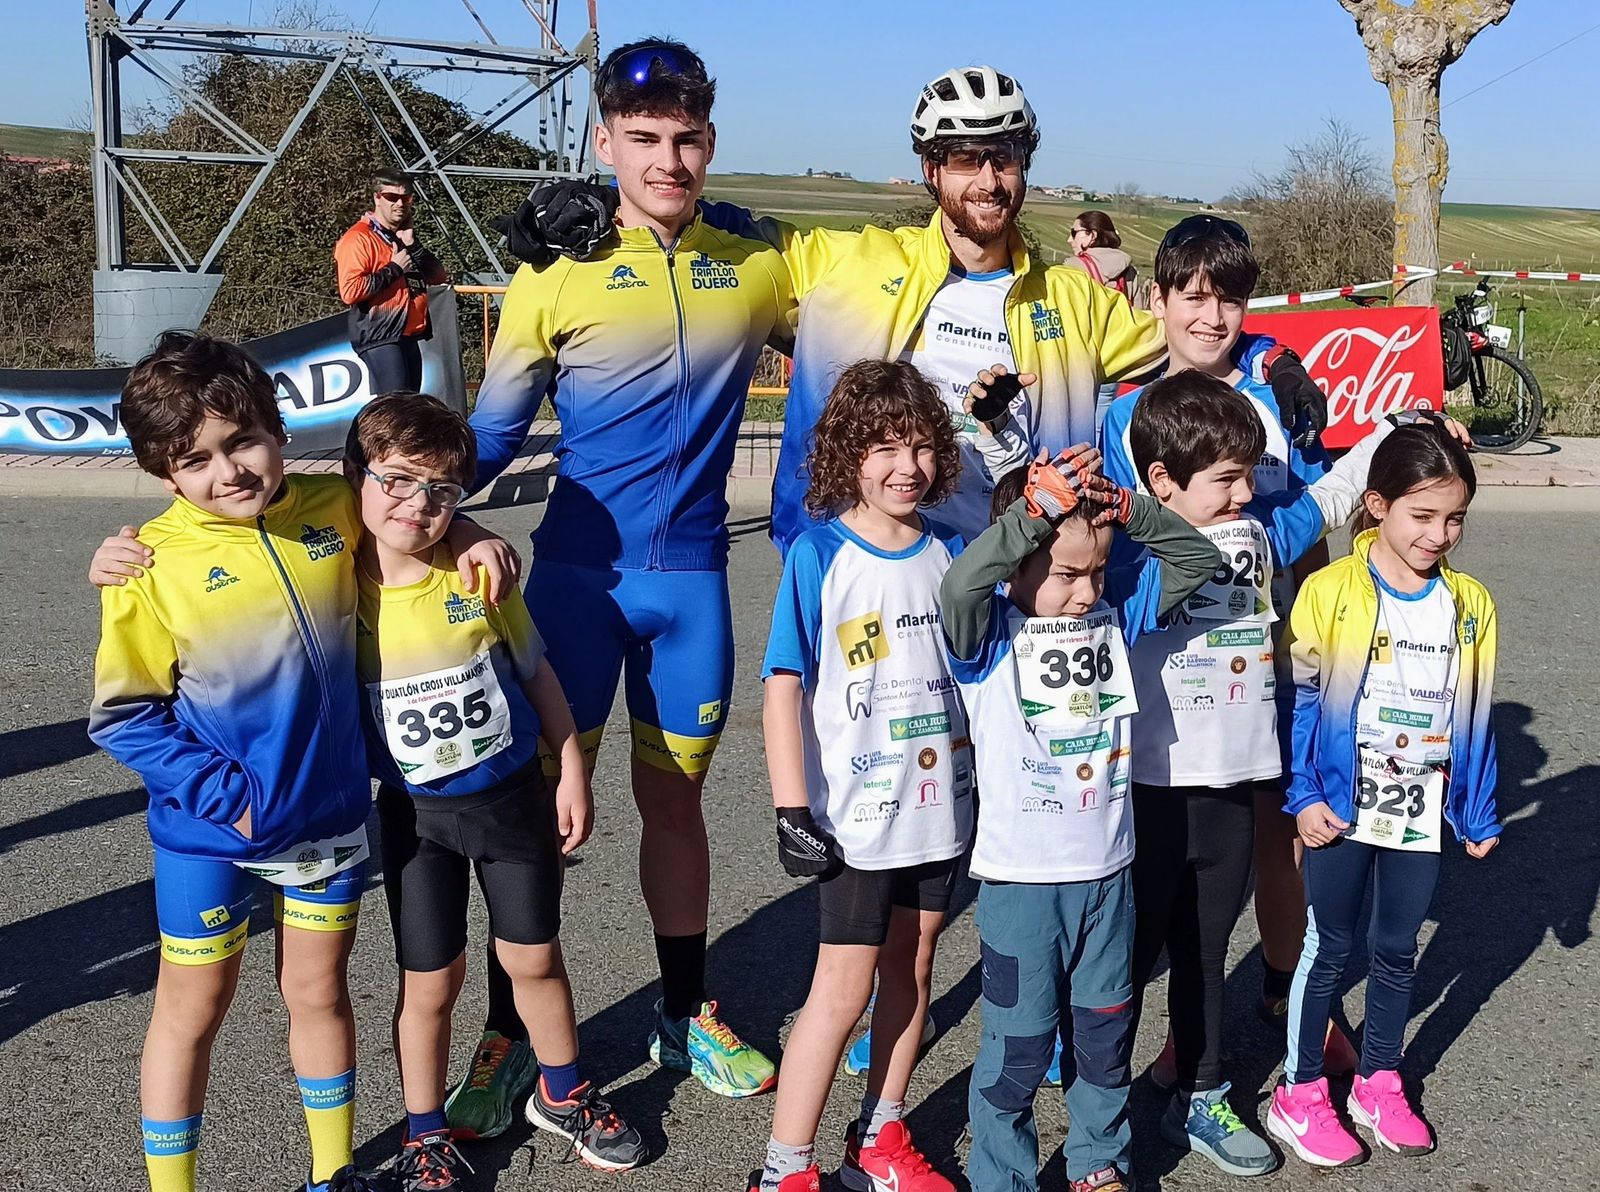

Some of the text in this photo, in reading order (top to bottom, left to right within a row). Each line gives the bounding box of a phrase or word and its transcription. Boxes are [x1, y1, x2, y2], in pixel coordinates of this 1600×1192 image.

[690, 267, 736, 278] TRIATLON
[606, 281, 650, 291] austral
[692, 277, 739, 290] DUERO
[938, 321, 992, 342] Martín
[1033, 326, 1065, 343] DUERO
[935, 333, 1013, 356] Construccio
[304, 531, 342, 550] TRIATLON
[1205, 528, 1231, 542] ATLÓN
[307, 540, 345, 562] DUERO
[205, 576, 241, 593] austral
[445, 599, 485, 615] TRIATLON
[447, 607, 486, 625] DUERO
[1030, 619, 1067, 634] DUATLÓN
[1067, 619, 1087, 633] CROSS
[1396, 639, 1435, 653] Martín
[1040, 642, 1114, 689] 336
[385, 682, 419, 700] DUATLÓN
[420, 678, 444, 693] CROSS
[891, 675, 924, 688] Dental
[397, 688, 492, 748] 335
[908, 715, 949, 729] CAJA RUR
[1360, 755, 1386, 771] ATLÓN
[281, 907, 329, 923] austral
[166, 944, 217, 956] austral
[309, 1089, 350, 1103] zamor
